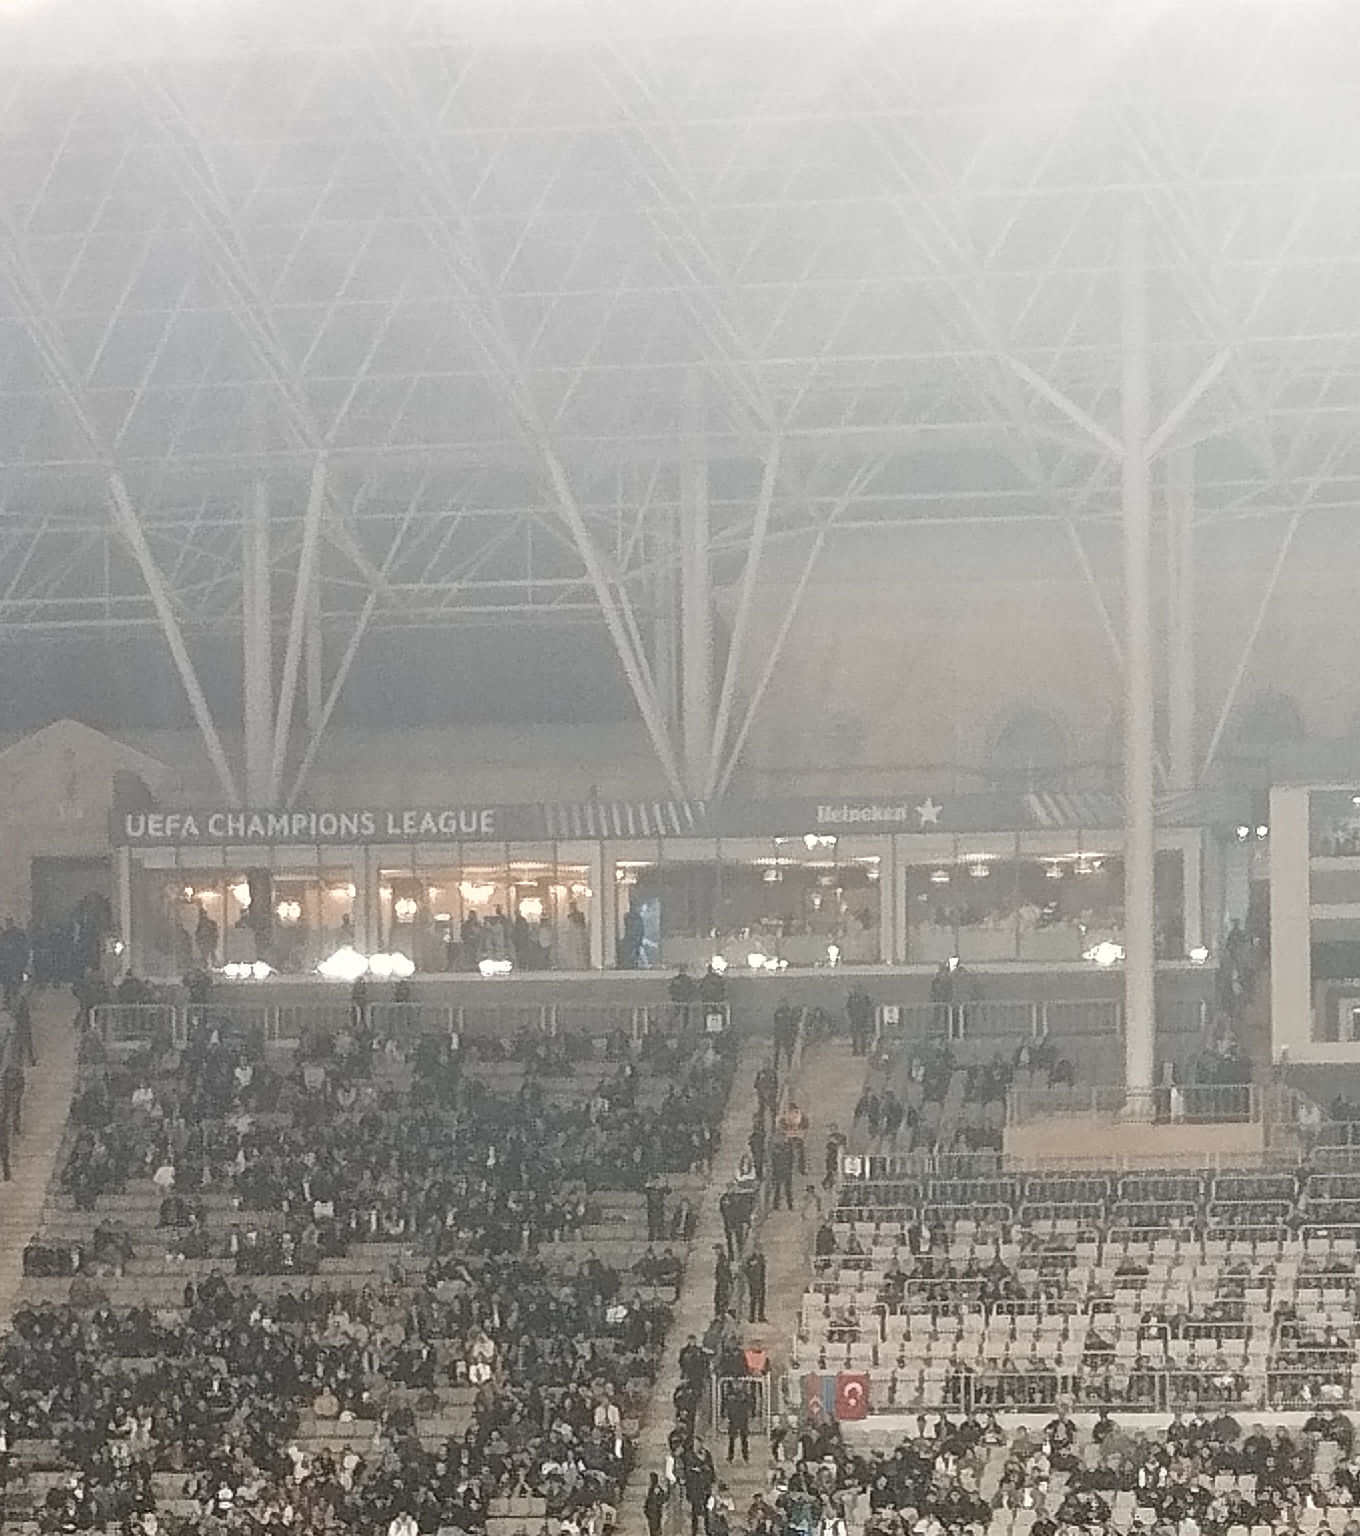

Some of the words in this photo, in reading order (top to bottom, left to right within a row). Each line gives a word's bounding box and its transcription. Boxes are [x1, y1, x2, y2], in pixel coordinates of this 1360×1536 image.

[125, 813, 200, 837] UEFA
[207, 811, 375, 837] CHAMPIONS
[387, 809, 496, 835] LEAGUE
